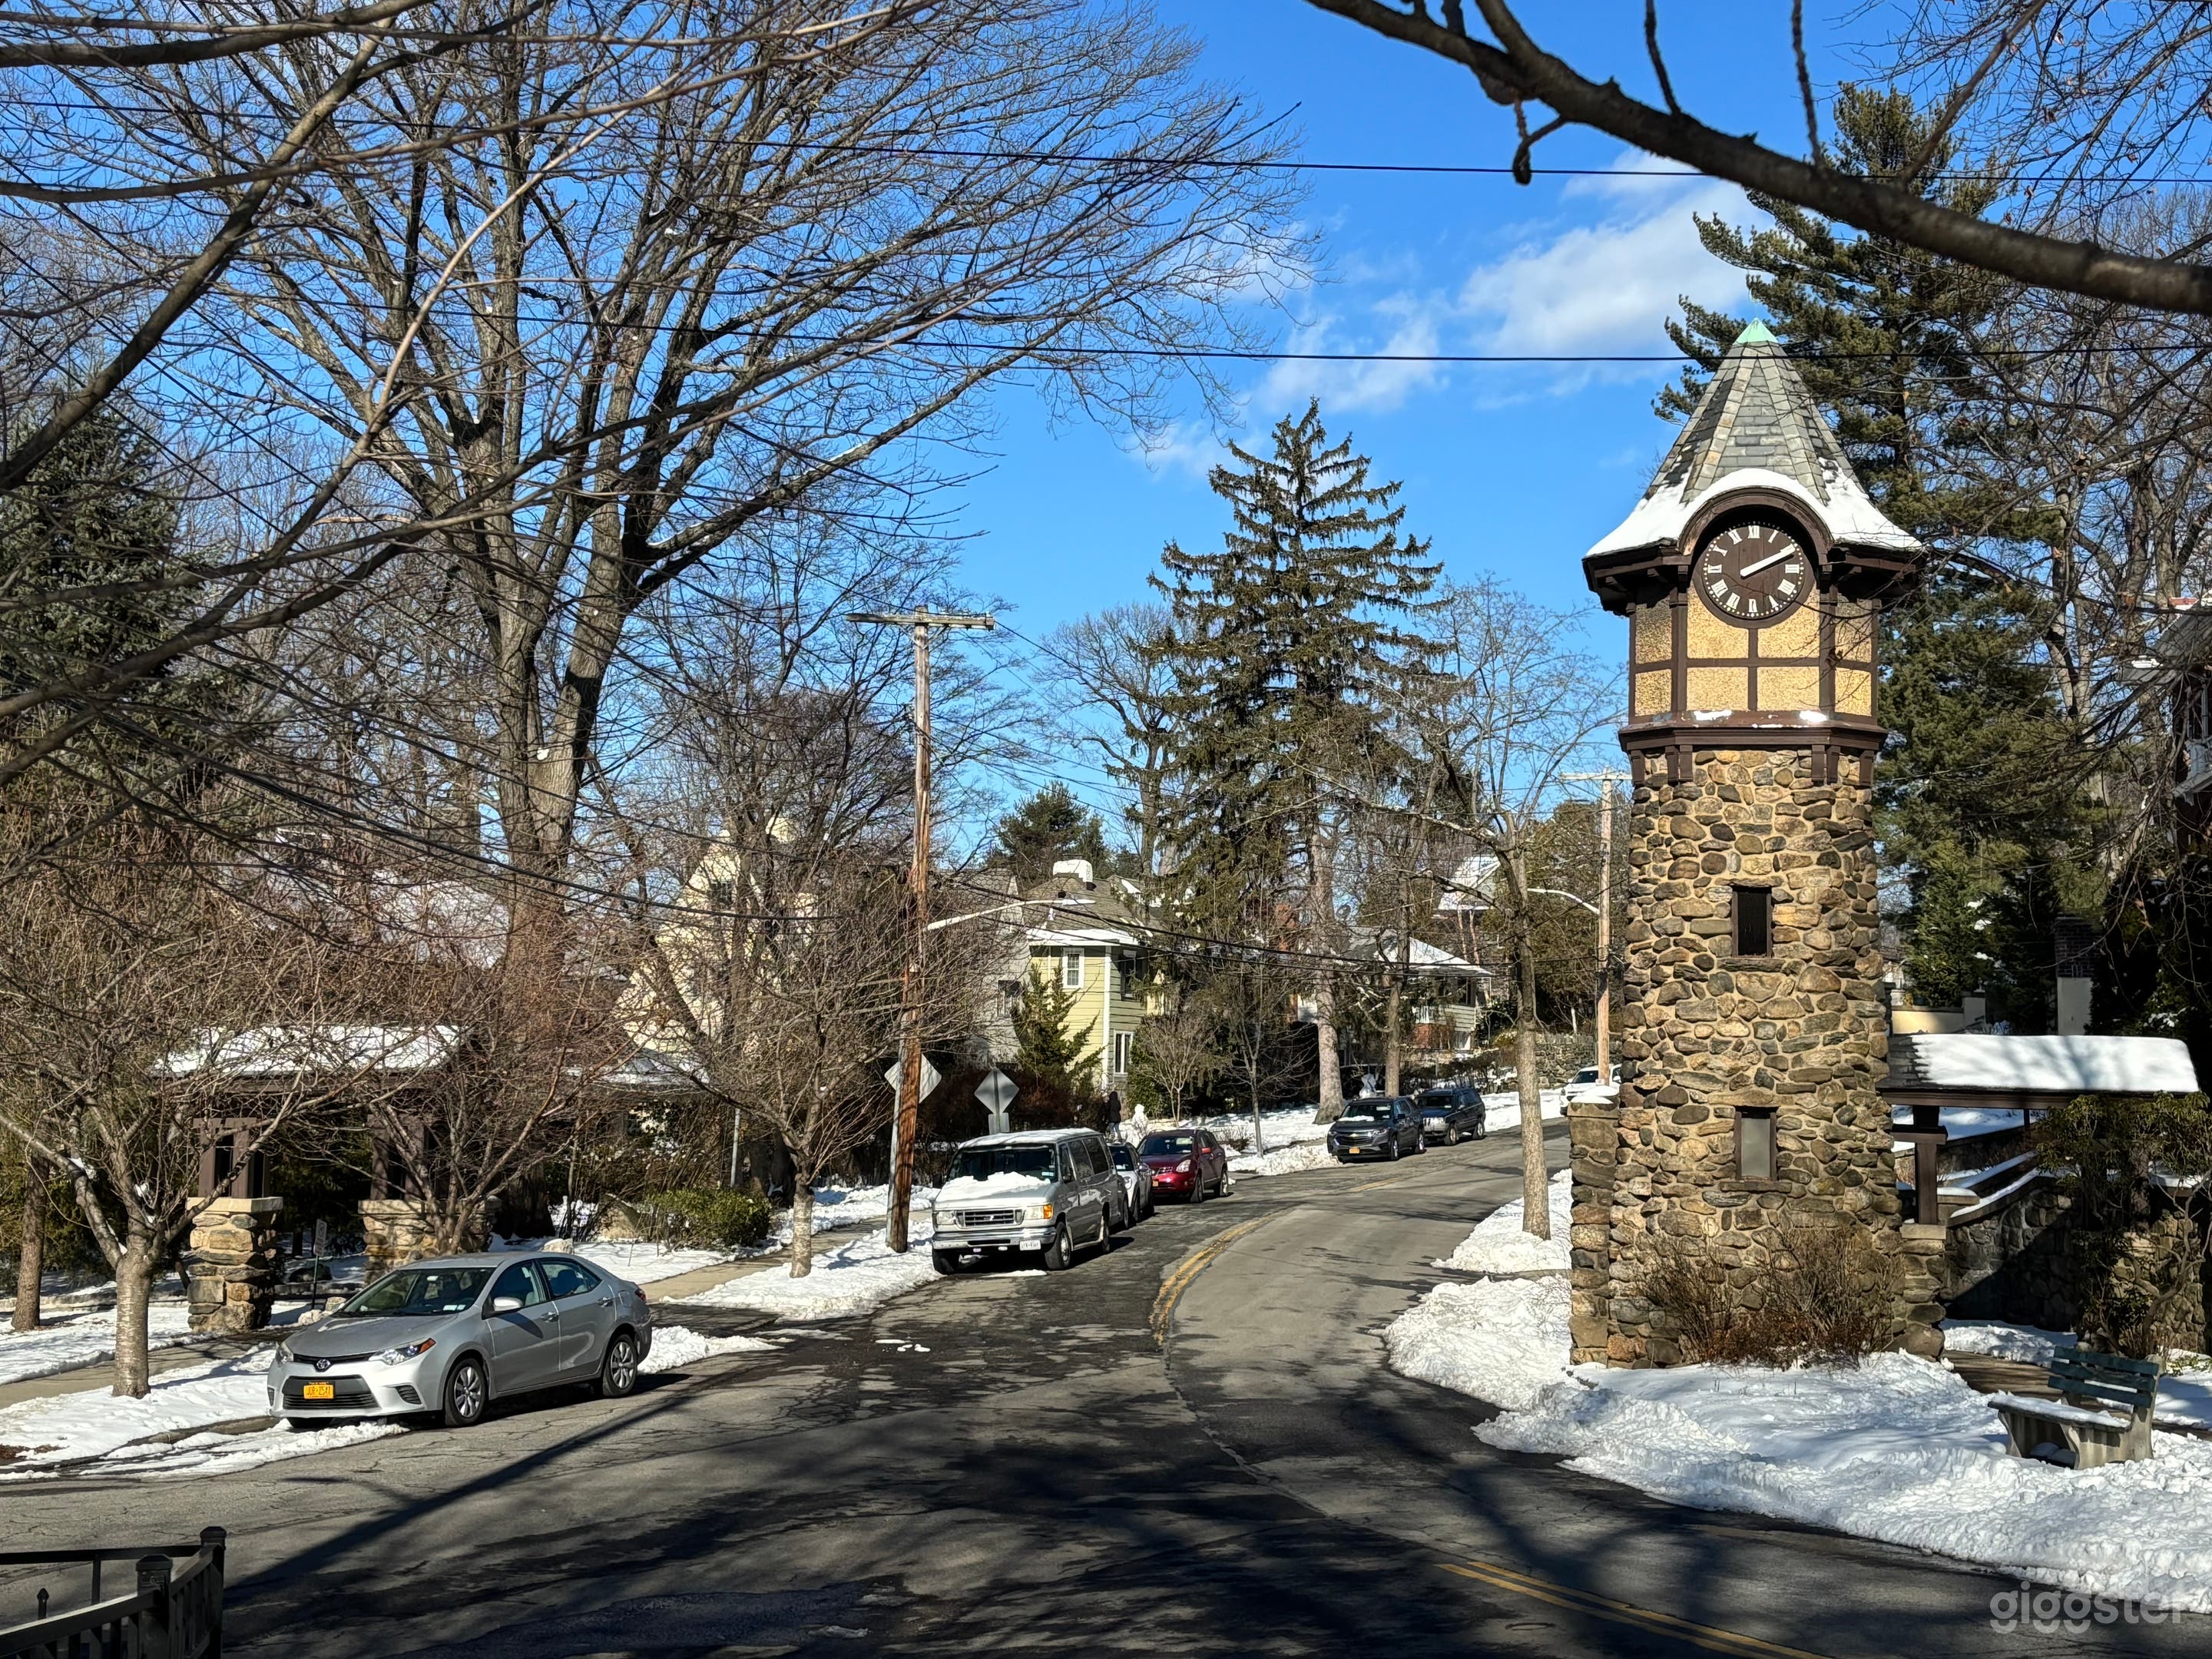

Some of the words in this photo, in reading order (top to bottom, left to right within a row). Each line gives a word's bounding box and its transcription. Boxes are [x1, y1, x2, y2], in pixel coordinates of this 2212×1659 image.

[1747, 525, 1760, 539] XII
[1767, 529, 1779, 544] I
[1713, 545, 1727, 557] X
[1785, 564, 1800, 574] III
[1748, 599, 1758, 612] VI
[1769, 595, 1779, 608] V
